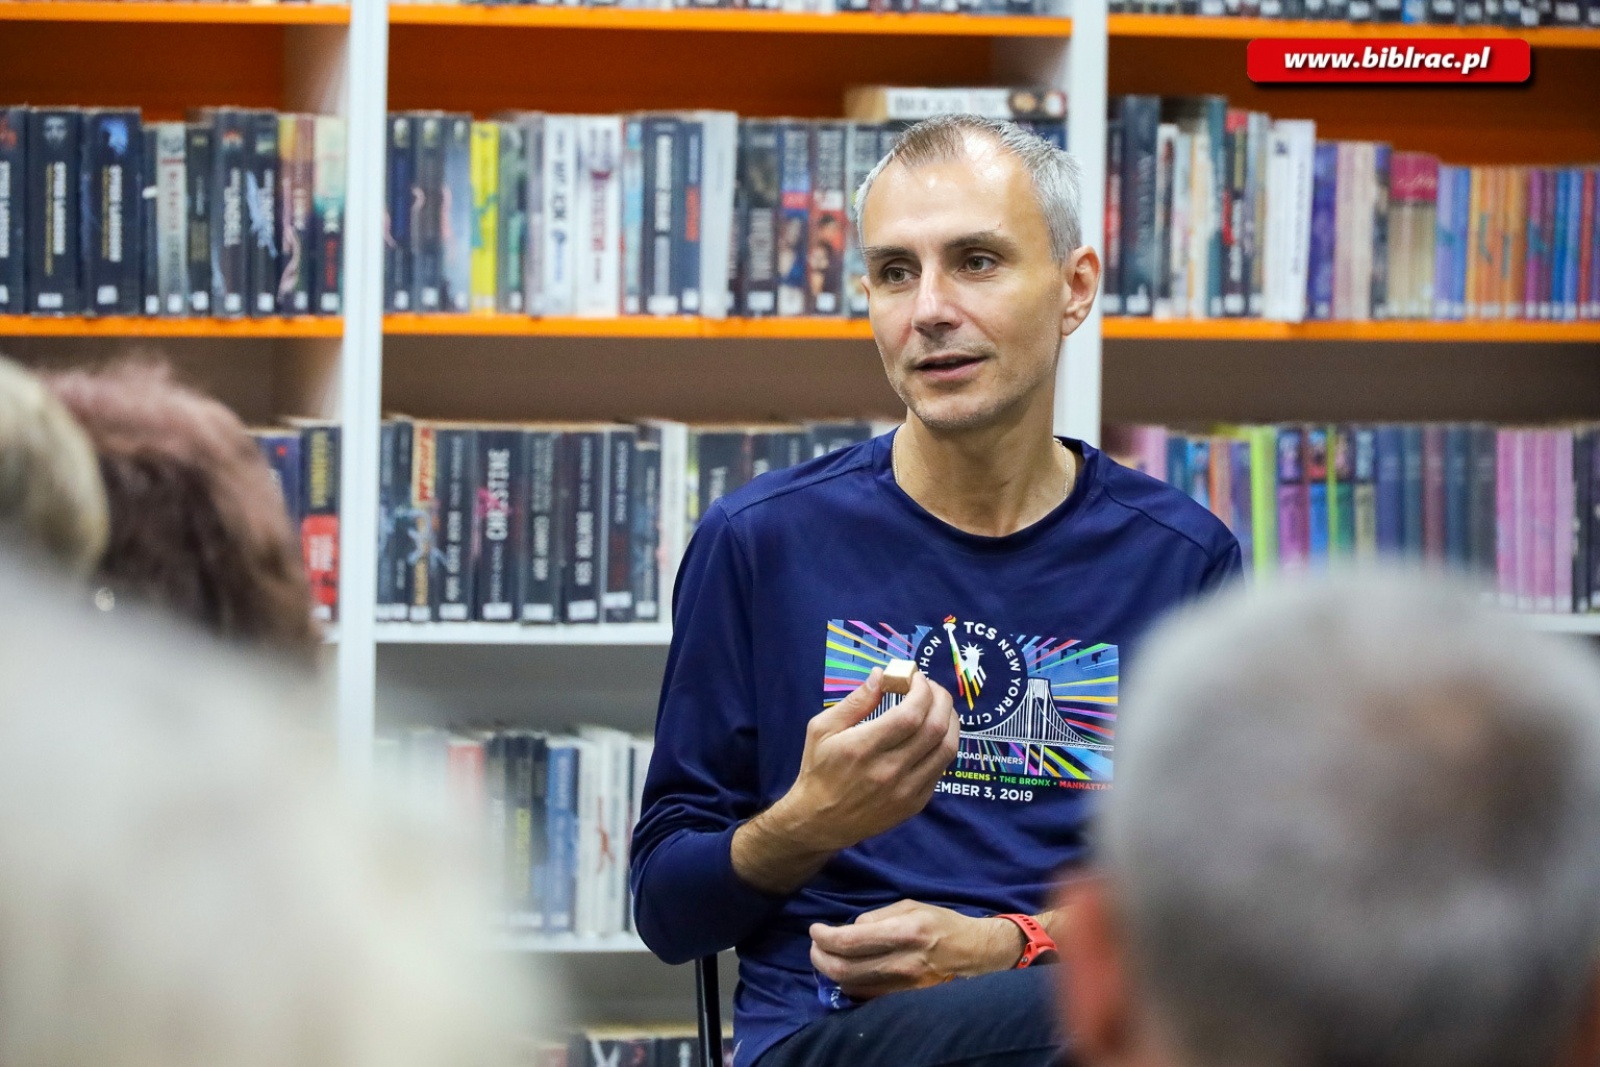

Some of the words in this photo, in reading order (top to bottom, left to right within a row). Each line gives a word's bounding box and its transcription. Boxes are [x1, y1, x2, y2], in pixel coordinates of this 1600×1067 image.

[963, 621, 998, 640] TCS
[997, 638, 1022, 672] NEW
[994, 677, 1022, 716] YORK
[956, 750, 981, 761] ROAD
[982, 755, 1024, 765] RUNNERS
[954, 770, 991, 782] QUEENS
[999, 775, 1017, 784] THE
[1019, 776, 1051, 787] BRONX
[983, 786, 996, 801] 3,
[999, 788, 1034, 802] 2019
